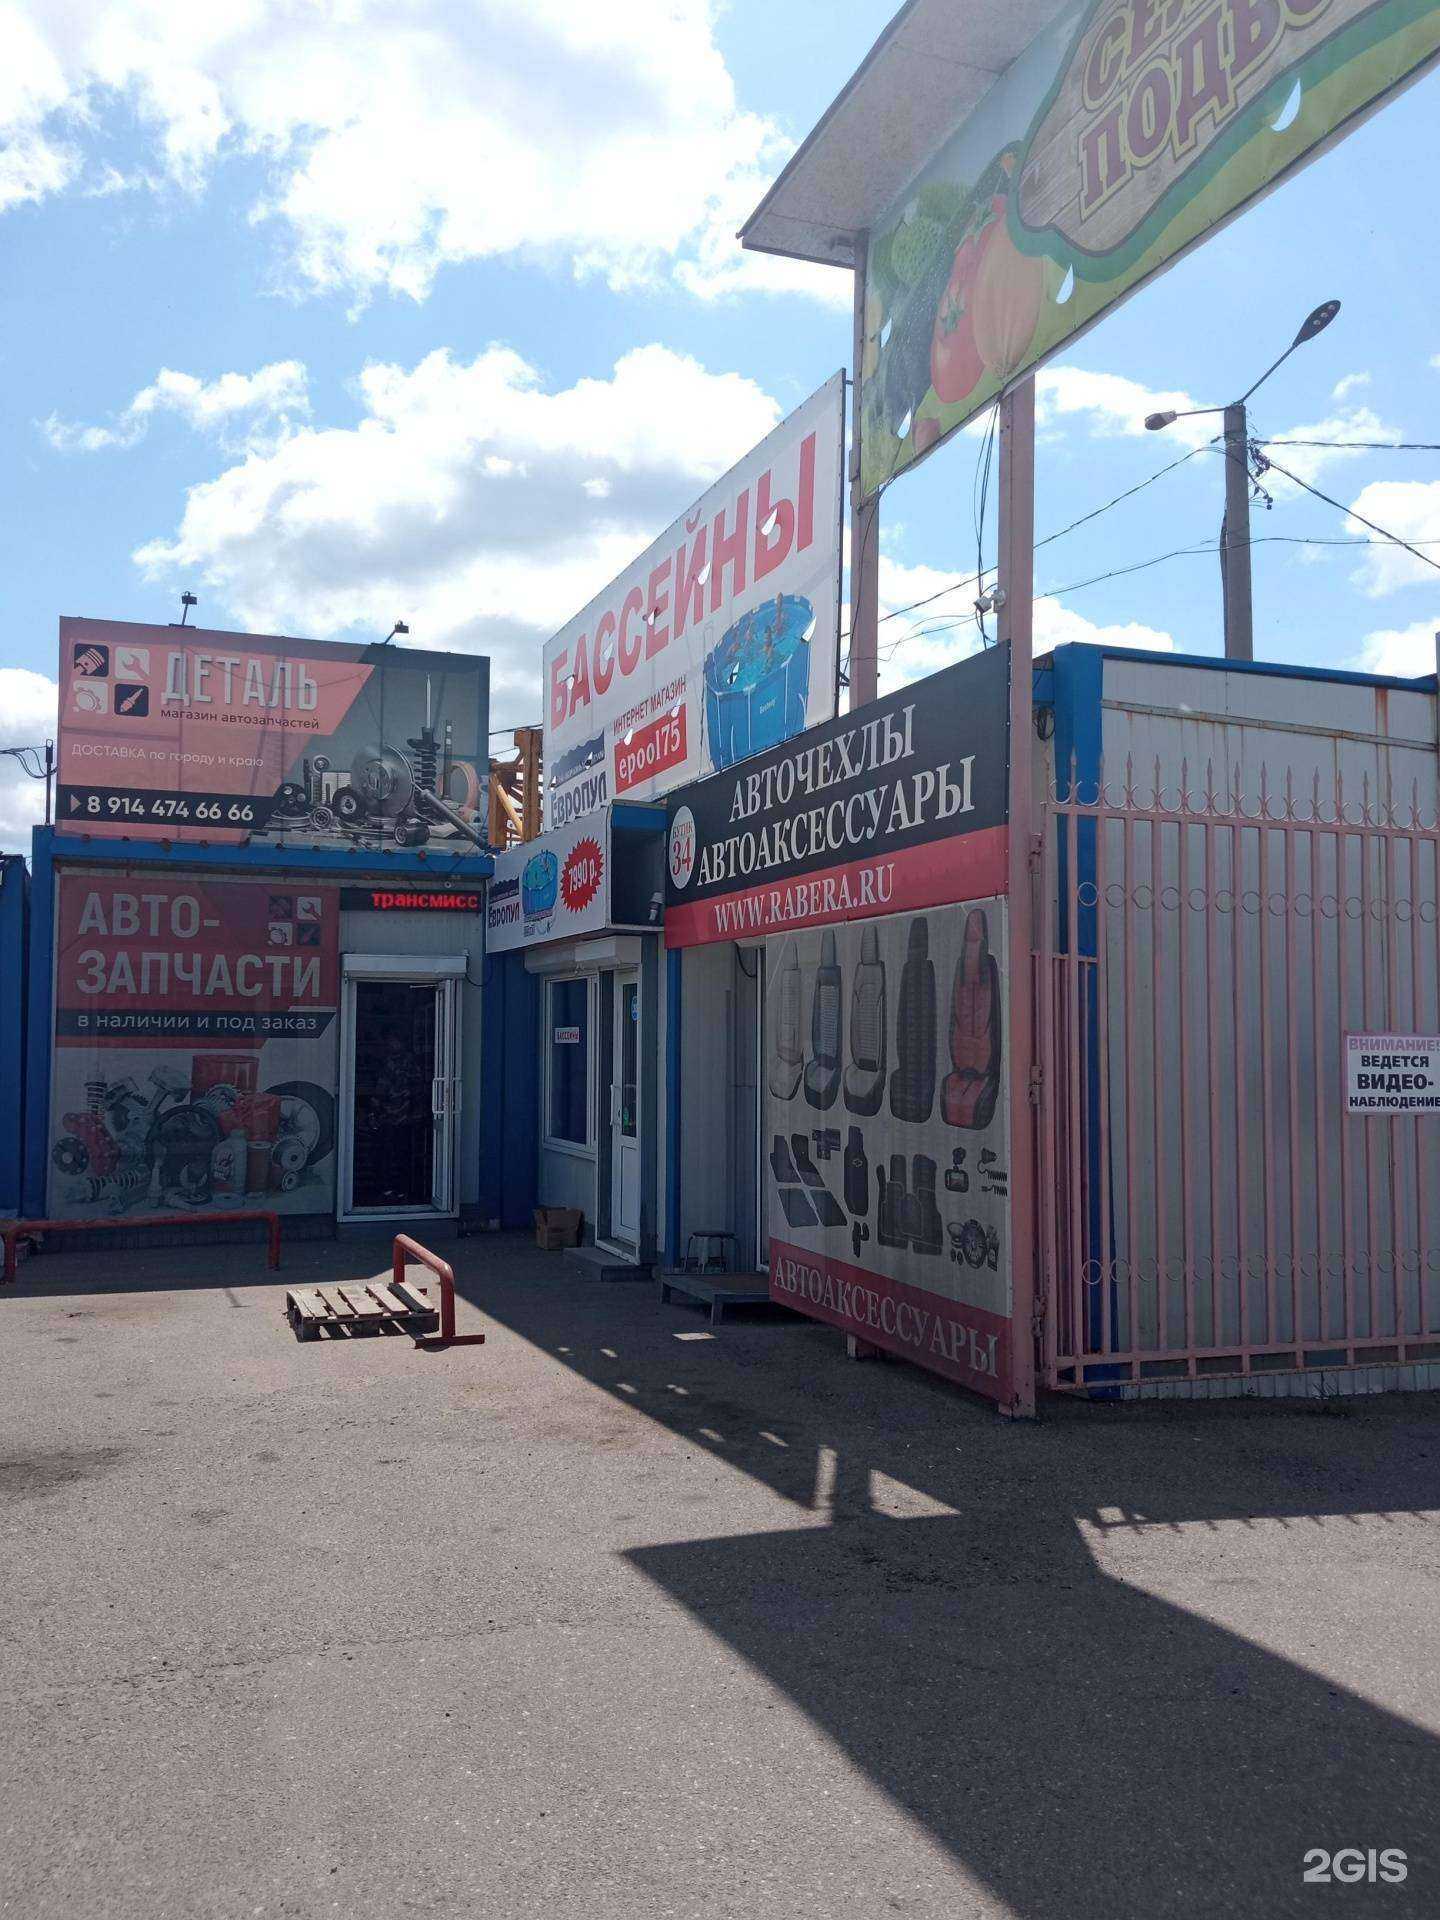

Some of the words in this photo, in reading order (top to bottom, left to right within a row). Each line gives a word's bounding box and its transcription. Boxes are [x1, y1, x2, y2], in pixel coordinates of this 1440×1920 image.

[550, 431, 816, 730] БАССЕЙНЫ
[161, 652, 318, 710] ДЕТАЛЬ
[161, 710, 218, 723] магазин
[222, 713, 320, 729] автозапчастей
[614, 699, 649, 736] ИНТЕРНЕТ
[650, 675, 687, 712] МАГАЗИН
[71, 743, 146, 760] ДОСТАВКА
[149, 751, 166, 760] по
[170, 752, 215, 766] городу
[218, 756, 227, 765] и
[229, 756, 264, 768] краю
[619, 719, 681, 784] epool75
[729, 704, 916, 823] АВТОЧЕХЛЫ
[87, 795, 100, 813] 8
[107, 796, 145, 815] 914
[151, 799, 189, 818] 474
[196, 802, 222, 820] 66
[228, 803, 254, 822] 66
[697, 755, 976, 887] АВТОАКСЕССУАРЫ
[673, 837, 692, 875] 34
[78, 892, 220, 938] АВТО-
[372, 893, 478, 909] трансмисс
[715, 863, 895, 933] WWW.RABERA.RU
[76, 950, 321, 999] ЗАПЧАСТИ
[78, 1015, 89, 1027] в
[96, 1015, 191, 1029] наличии
[197, 1017, 209, 1029] и
[216, 1017, 256, 1031] под
[261, 1017, 317, 1030] заказ
[1357, 1074, 1434, 1093] ВИДЕО-
[1361, 1055, 1429, 1069] ВЕДЕТСЯ
[1349, 1096, 1440, 1109] НАБЛЮДЕНИЕ
[774, 1256, 999, 1378] АВТОАКСЕССУАРЫ
